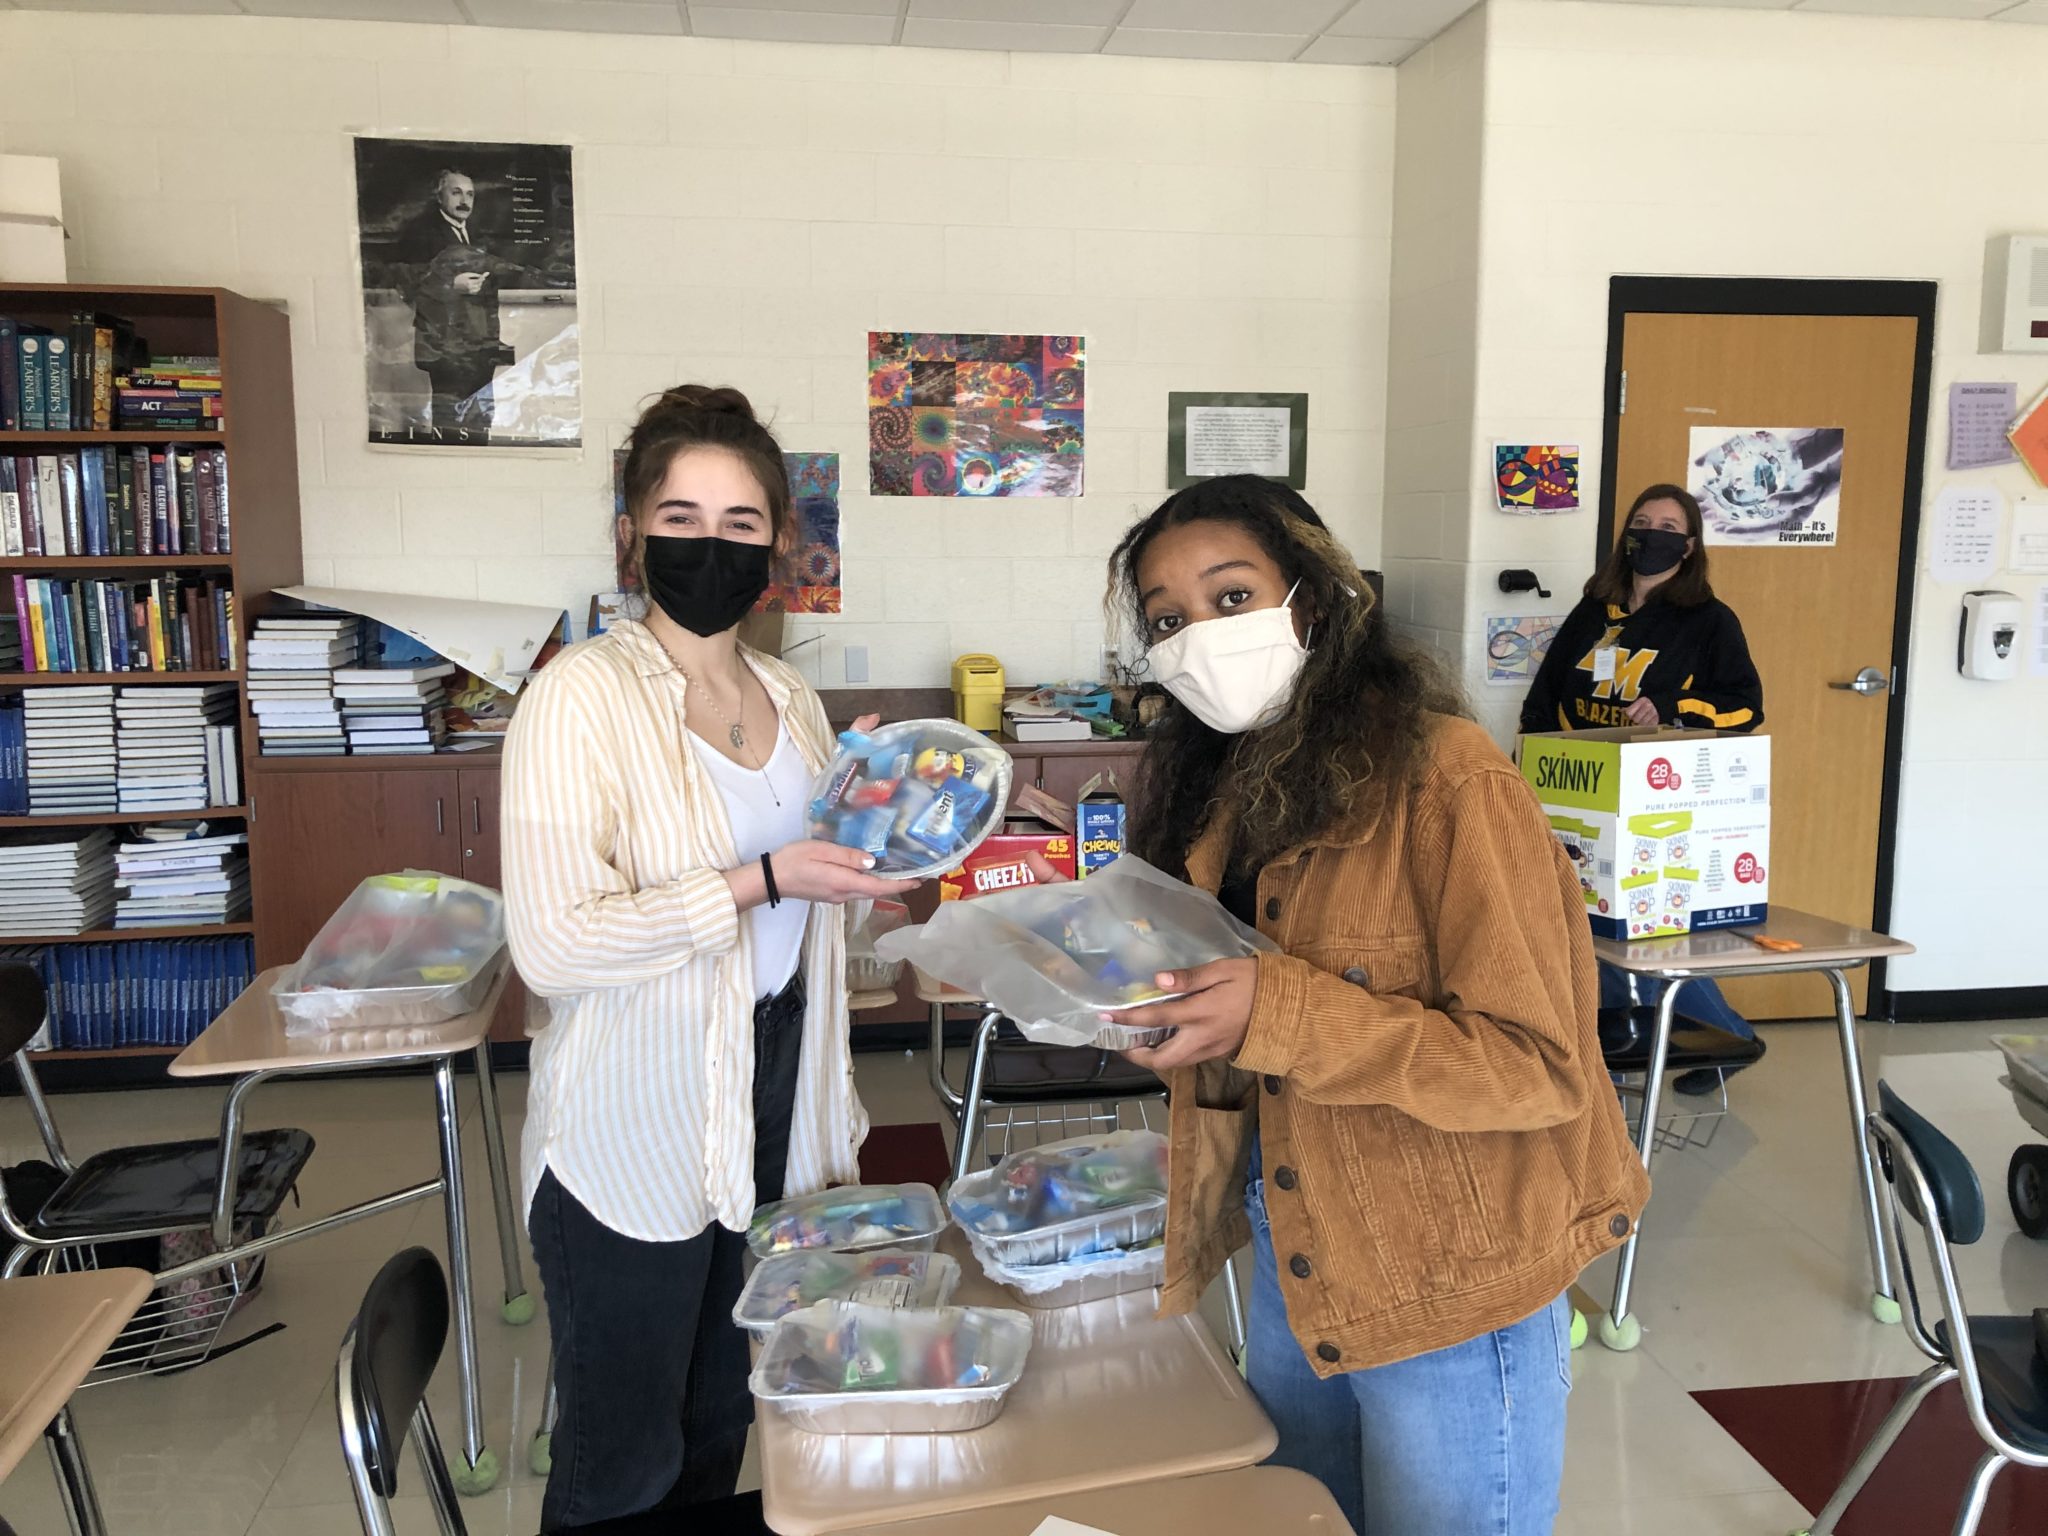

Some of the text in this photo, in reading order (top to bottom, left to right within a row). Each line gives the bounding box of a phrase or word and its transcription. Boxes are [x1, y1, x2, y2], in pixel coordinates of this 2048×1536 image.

[23, 355, 35, 412] LEARNER'S
[49, 355, 61, 412] LEARNER'S
[96, 359, 107, 401] Geometry
[141, 401, 162, 411] ACT
[157, 484, 167, 520] CALCULUS
[6, 495, 17, 529] CALCULUS
[1812, 520, 1826, 532] it's
[1778, 531, 1835, 543] Everywhere!
[1650, 763, 1670, 779] 28
[1645, 797, 1746, 811] PURE POPPED PERFECTION
[1092, 813, 1111, 821] 100%
[1046, 838, 1069, 853] 45
[1737, 857, 1754, 873] 28
